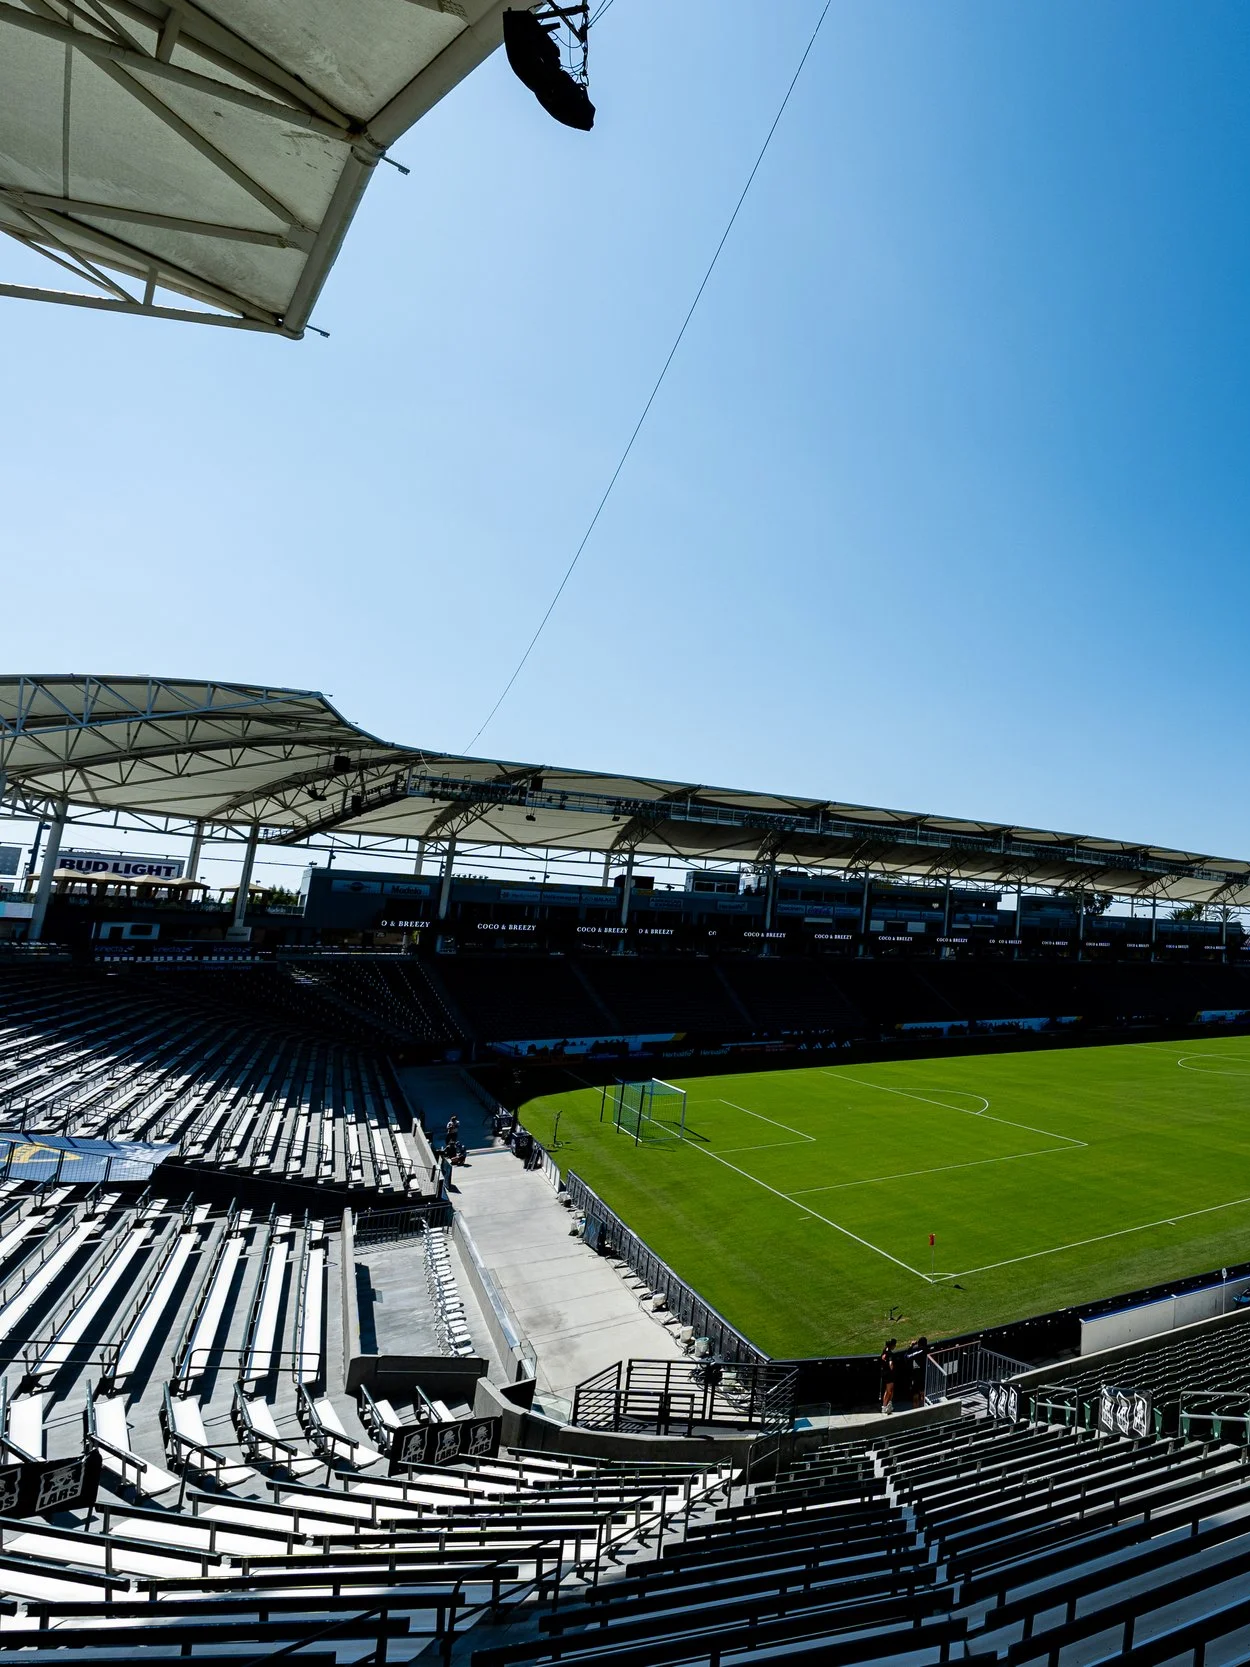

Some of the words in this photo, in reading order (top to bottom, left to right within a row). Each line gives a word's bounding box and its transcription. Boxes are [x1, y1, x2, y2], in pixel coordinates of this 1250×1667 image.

[60, 858, 109, 872] BUD
[112, 862, 176, 877] LIGHT
[39, 1485, 78, 1509] LARS
